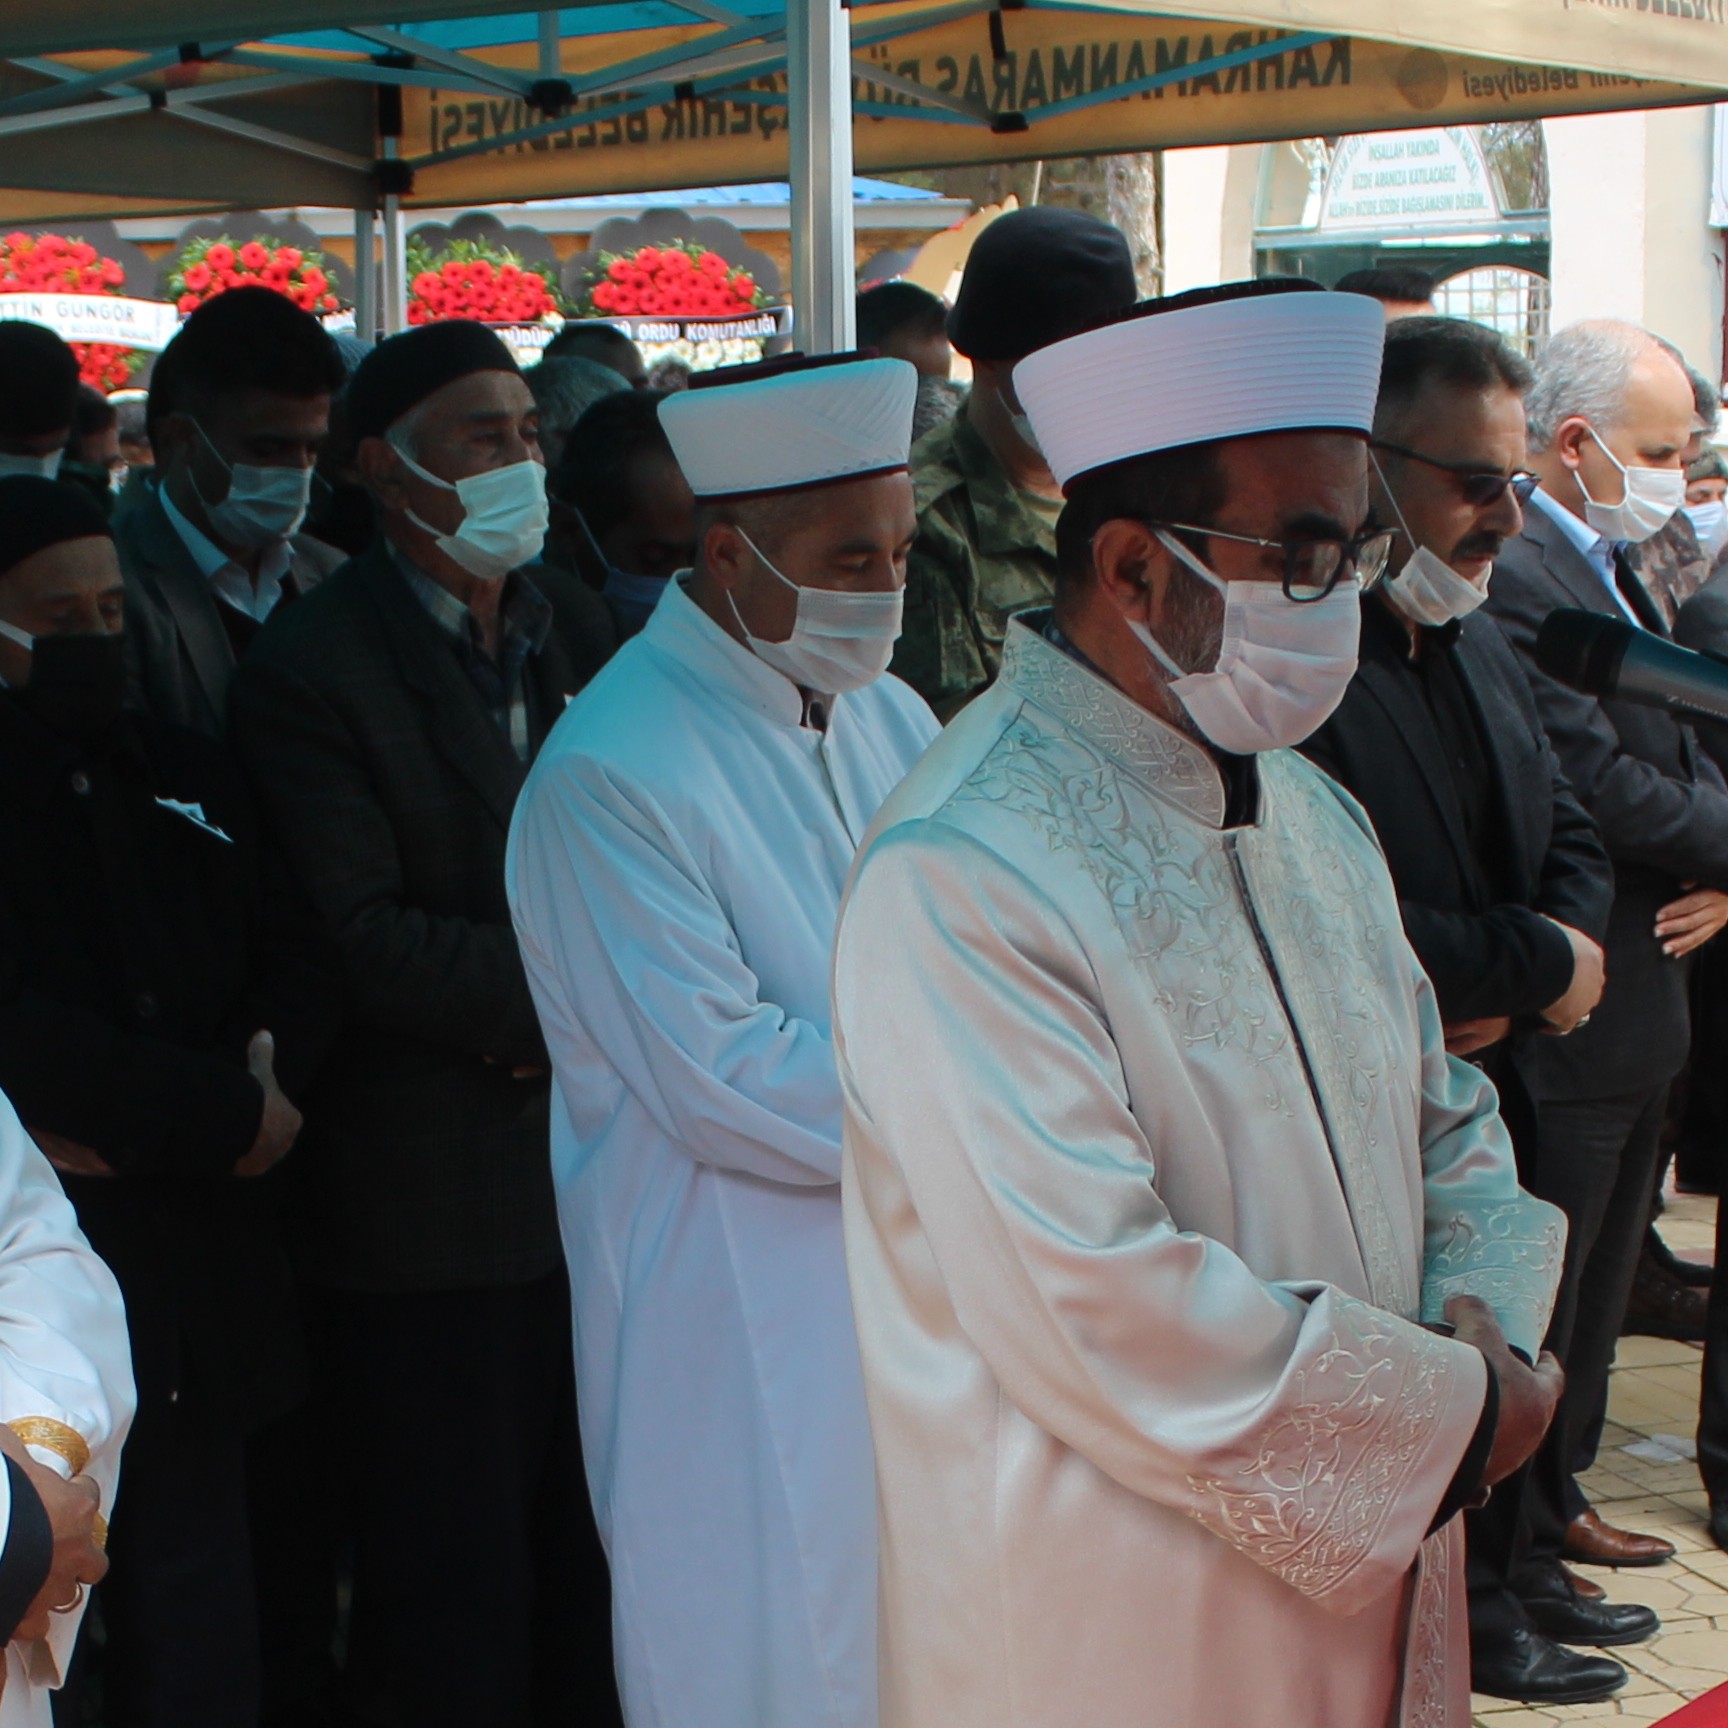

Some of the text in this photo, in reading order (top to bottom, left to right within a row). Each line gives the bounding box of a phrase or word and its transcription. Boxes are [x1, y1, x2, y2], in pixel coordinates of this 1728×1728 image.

[56, 299, 136, 324] GÜNGÖR
[638, 322, 681, 342] ORDU
[685, 314, 777, 343] KOMUTANLIĞI
